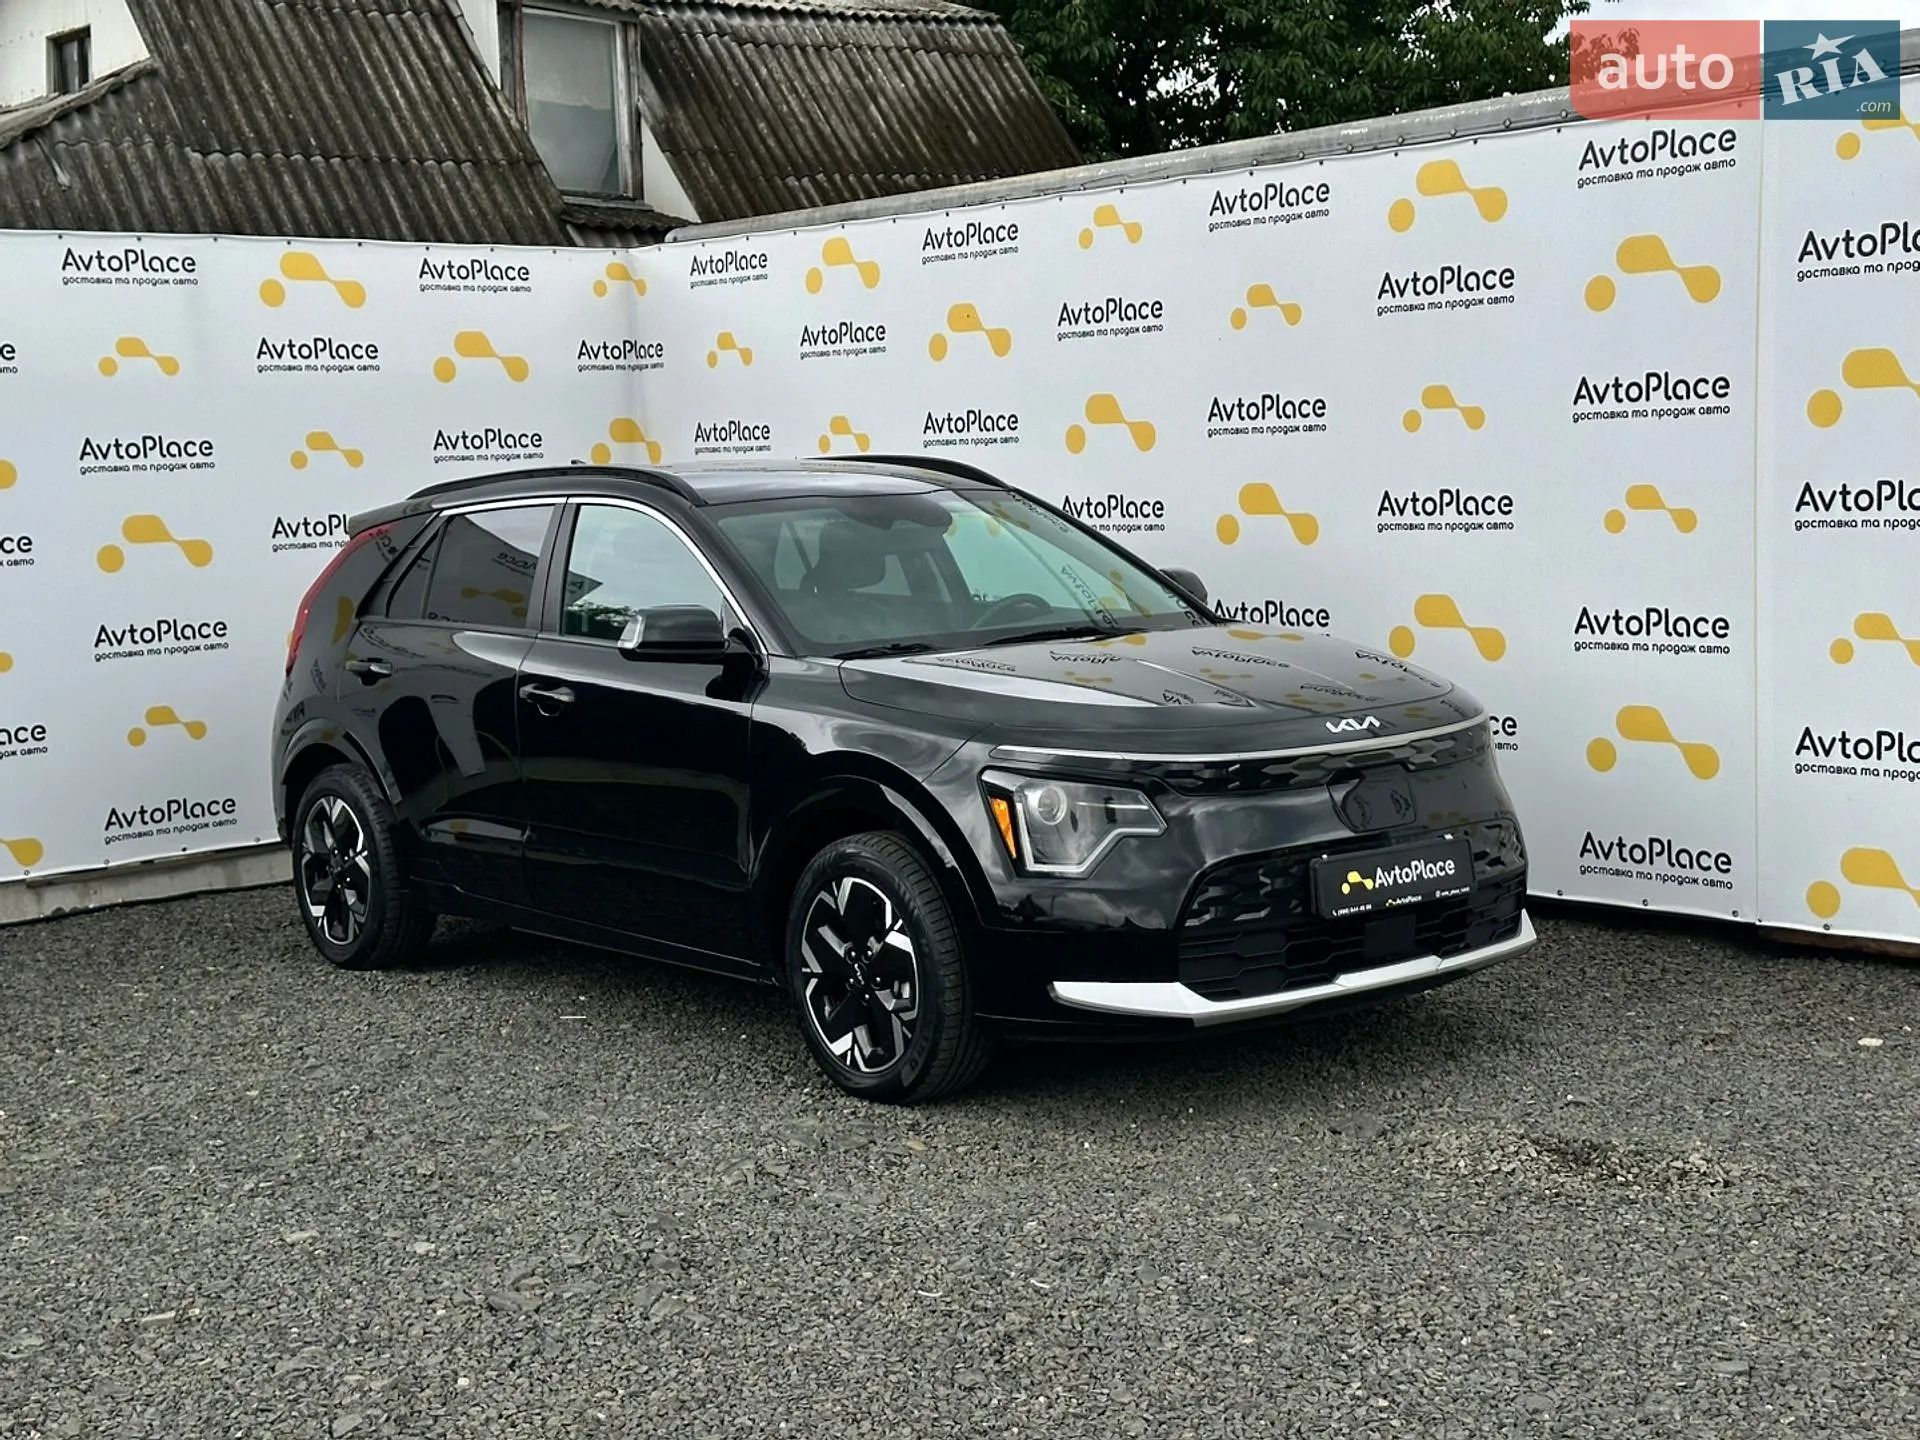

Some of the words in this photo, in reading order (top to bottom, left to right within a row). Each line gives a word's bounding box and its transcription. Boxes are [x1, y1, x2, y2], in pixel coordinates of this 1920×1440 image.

[1579, 129, 1737, 171] AvtoPlace
[1577, 171, 1634, 189] доставка
[1636, 168, 1654, 179] та
[1656, 163, 1701, 178] продаж
[1704, 158, 1736, 171] авто
[1209, 182, 1330, 217] AvtoPlace
[1208, 218, 1251, 233] доставка
[1253, 216, 1266, 224] та
[1268, 212, 1303, 225] продаж
[1304, 208, 1330, 219] авто
[922, 221, 1018, 251] AvtoPlace
[61, 247, 196, 273] AvtoPlace
[690, 250, 768, 276] AvtoPlace
[922, 253, 956, 265] доставка
[970, 249, 997, 259] продаж
[999, 246, 1019, 255] авто
[419, 258, 530, 281] AvtoPlace
[1797, 265, 1861, 282] доставка
[1863, 263, 1884, 273] та
[62, 277, 113, 286] доставка
[115, 277, 130, 285] та
[132, 277, 170, 287] продаж
[419, 284, 461, 292] доставка
[477, 285, 508, 294] продаж
[1377, 264, 1515, 300] AvtoPlace
[1058, 297, 1163, 327] AvtoPlace
[1377, 303, 1425, 317] доставка
[1427, 301, 1443, 310] та
[1445, 298, 1484, 311] продаж
[1487, 295, 1515, 305] авто
[800, 321, 886, 347] AvtoPlace
[1057, 330, 1095, 342] доставка
[1096, 328, 1108, 336] та
[1110, 326, 1140, 337] продаж
[1141, 324, 1163, 333] авто
[256, 337, 378, 360] AvtoPlace
[577, 339, 663, 360] AvtoPlace
[257, 364, 303, 373] доставка
[320, 364, 355, 373] продаж
[1573, 371, 1730, 406] AvtoPlace
[1208, 393, 1326, 423] AvtoPlace
[1572, 410, 1629, 424] доставка
[1631, 409, 1648, 418] та
[1651, 407, 1696, 420] продаж
[1698, 405, 1730, 415] авто
[694, 420, 770, 443] AvtoPlace
[923, 409, 1018, 434] AvtoPlace
[1207, 427, 1250, 438] доставка
[1251, 426, 1264, 434] та
[1266, 425, 1300, 436] продаж
[1302, 424, 1327, 432] авто
[79, 435, 213, 461] AvtoPlace
[433, 428, 542, 451] AvtoPlace
[923, 439, 957, 449] доставка
[971, 437, 998, 447] продаж
[999, 436, 1019, 444] авто
[80, 465, 130, 476] доставка
[149, 463, 188, 472] продаж
[434, 455, 475, 464] доставка
[490, 453, 521, 462] продаж
[1062, 493, 1165, 519] AvtoPlace
[1377, 488, 1513, 517] AvtoPlace
[271, 513, 349, 539] AvtoPl
[1112, 523, 1142, 534] продаж
[1143, 523, 1166, 532] авто
[1377, 523, 1425, 533] доставка
[1427, 522, 1443, 531] та
[1445, 522, 1484, 533] продаж
[1486, 522, 1514, 530] авто
[1794, 519, 1858, 532] доставка
[1861, 519, 1881, 528] та
[271, 540, 317, 553] доставка
[319, 540, 333, 548] та
[6, 558, 35, 567] авто
[1214, 599, 1331, 628] AvtoPlace
[1574, 606, 1730, 639] AvtoPlace
[94, 618, 227, 648] AvtoPlace
[94, 649, 144, 662] доставка
[147, 648, 162, 656] та
[164, 645, 201, 656] продаж
[203, 642, 229, 651] авто
[1574, 641, 1629, 652] доставка
[1632, 642, 1649, 651] та
[1652, 643, 1696, 655] продаж
[1699, 645, 1730, 654] авто
[1325, 715, 1381, 734] KIA
[20, 746, 48, 756] авто
[1794, 763, 1858, 775] доставка
[1860, 767, 1880, 777] та
[104, 798, 236, 831] AvtoPlace
[104, 829, 154, 845] доставка
[156, 827, 171, 835] та
[173, 822, 210, 834] продаж
[212, 818, 237, 828] авто
[1579, 831, 1732, 874] AvtoPlace
[1375, 859, 1456, 889] AvtoPlace
[1579, 864, 1633, 878] доставка
[1636, 871, 1653, 881] та
[1655, 873, 1699, 886] продаж
[1702, 878, 1733, 890] авто
